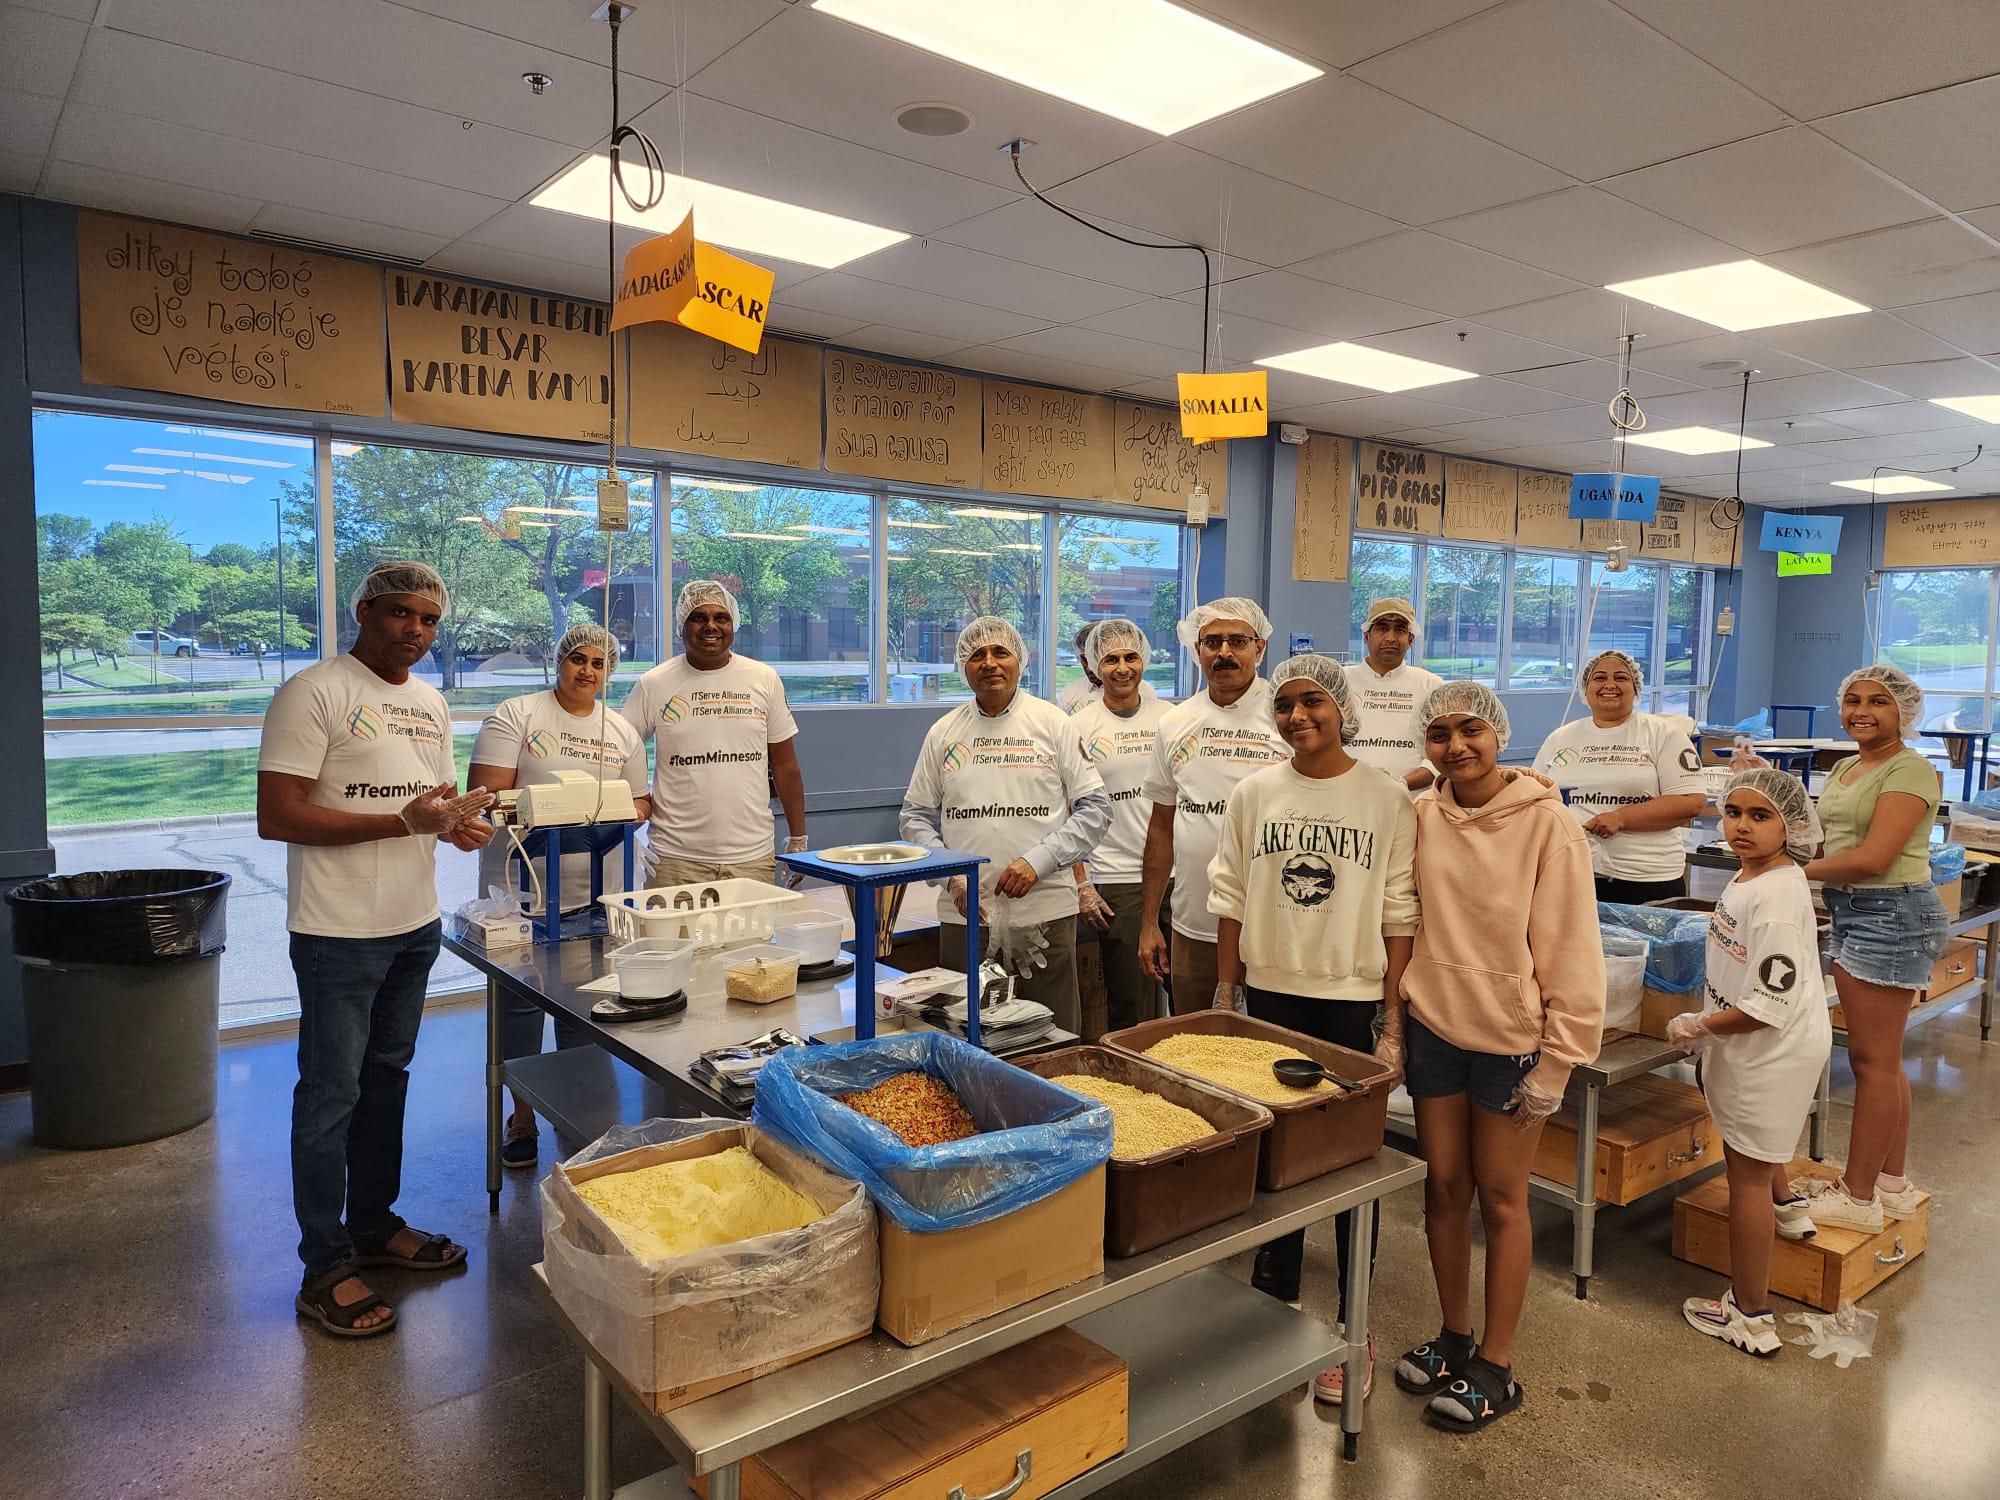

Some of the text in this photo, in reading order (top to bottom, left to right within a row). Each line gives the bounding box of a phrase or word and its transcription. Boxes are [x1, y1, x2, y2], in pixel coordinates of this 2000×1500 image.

[130, 286, 187, 335] je
[396, 276, 611, 336] HARAPAN LEBIH
[461, 326, 552, 363] BESAR
[403, 360, 610, 405] KARENA KAMU
[851, 362, 956, 401] esperança
[852, 394, 913, 421] maior
[994, 390, 1032, 416] Mas
[1183, 396, 1264, 415] SOMALIA
[991, 423, 1087, 458] ang pag asa
[886, 434, 949, 466] causa
[993, 455, 1028, 488] dahil
[1360, 474, 1377, 498] PI
[1401, 479, 1441, 506] GRAS
[1376, 502, 1387, 527] A
[1899, 507, 1929, 524] 당신은
[1775, 527, 1822, 539] KENYA
[1786, 556, 1822, 566] LATVIA
[691, 691, 750, 701] ITServe Alliance
[1364, 690, 1413, 699] ITServe Alliance
[382, 703, 409, 717] ITServe
[692, 706, 721, 716] ITServe
[723, 706, 752, 715] Alliance
[1363, 702, 1414, 710] ITServe Alliance
[387, 724, 414, 737] ITServe
[1114, 731, 1139, 741] ITServe
[1202, 728, 1271, 741] ITServe Alliance
[561, 732, 589, 745] ITServe
[973, 736, 1035, 748] ITServe Alliance
[561, 746, 591, 760] ITServe
[1117, 745, 1142, 755] ITServe
[1200, 747, 1232, 758] ITServe
[1234, 747, 1269, 760] Alliance
[1611, 744, 1640, 752] Alliance
[669, 750, 762, 767] #TeamMinnesota
[972, 754, 1002, 765] ITServe
[1003, 753, 1035, 763] Alliance
[1608, 755, 1639, 763] Alliance
[946, 803, 1050, 820] #TeamMinnesota
[1281, 809, 1346, 825] Switzerland
[1251, 821, 1374, 870] LAKE GENEVA
